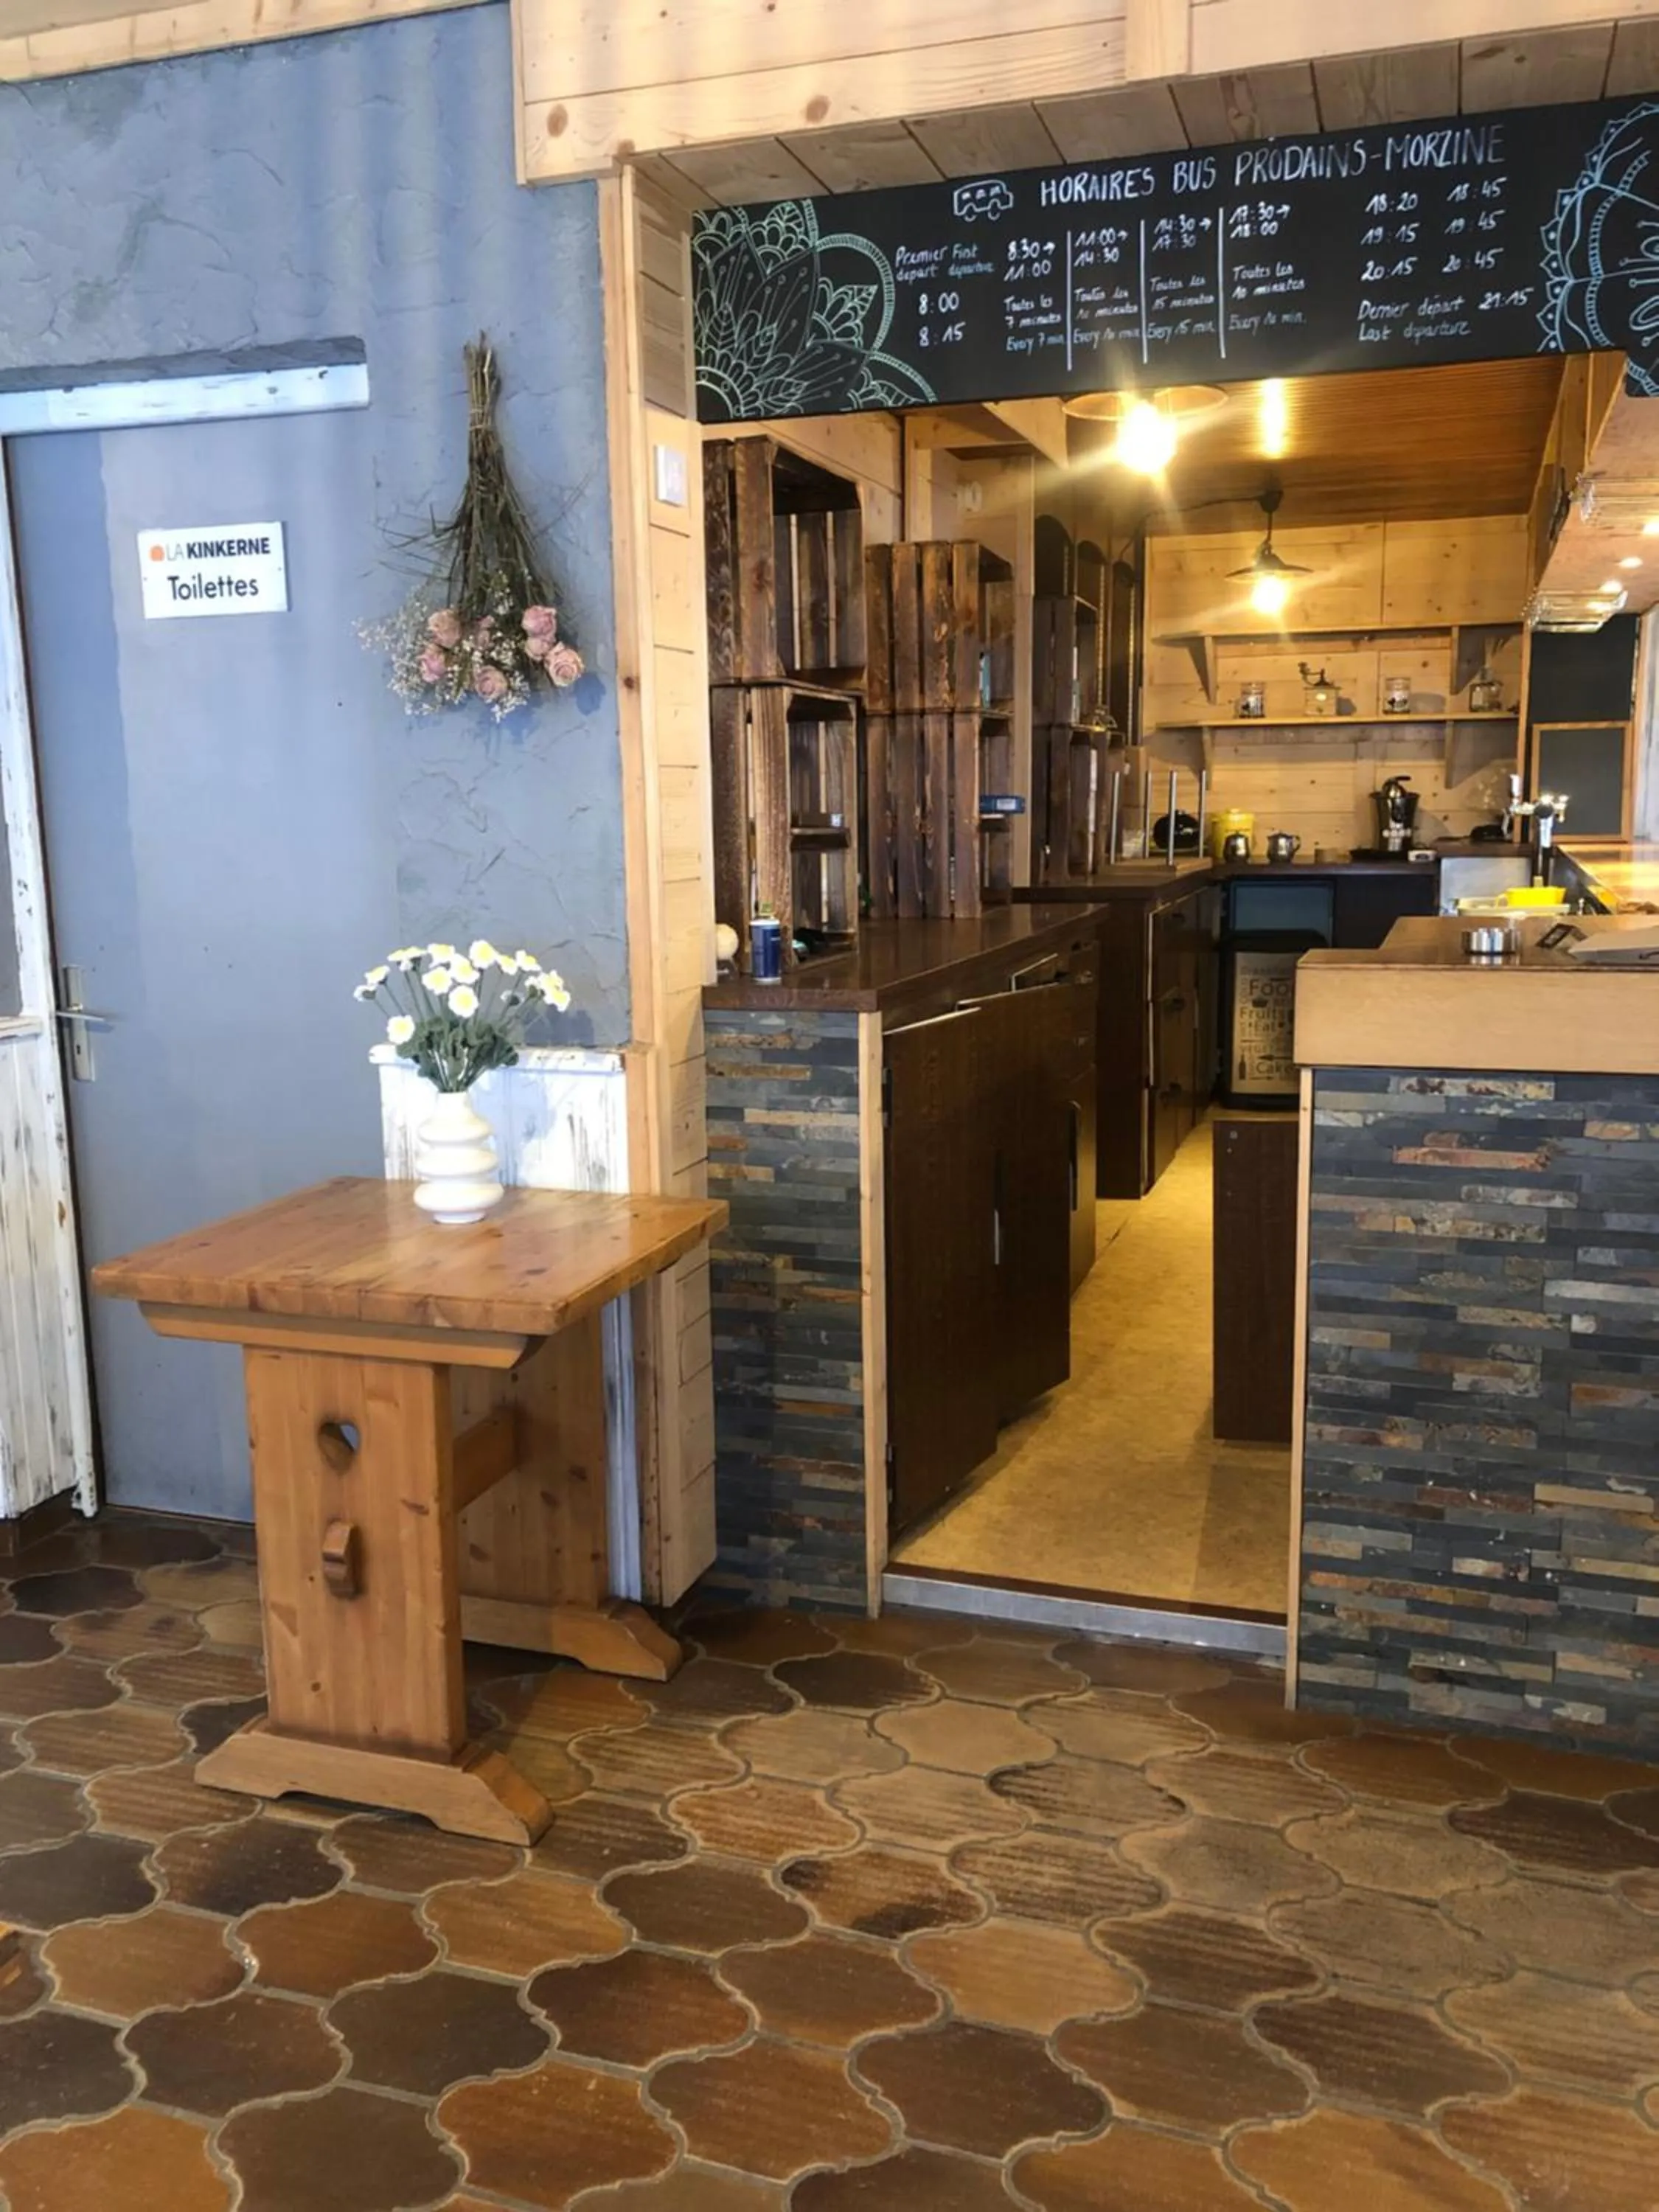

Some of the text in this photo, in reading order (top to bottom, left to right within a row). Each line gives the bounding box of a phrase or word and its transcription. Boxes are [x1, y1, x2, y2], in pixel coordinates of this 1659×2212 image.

[1040, 167, 1155, 206] HORAIRES
[1173, 156, 1216, 193] BUS
[1365, 177, 1507, 215] 18:20 18:45
[1154, 213, 1196, 234] 14:30
[1228, 201, 1275, 224] 17:30
[1074, 227, 1116, 248] 11:00
[1230, 221, 1279, 239] 18:00
[1360, 209, 1506, 245] 19:15 19:45
[895, 246, 947, 268] Premier
[1008, 238, 1040, 261] 8:30
[1074, 247, 1119, 267] 14:30
[1004, 260, 1051, 282] 11:00
[1232, 264, 1270, 282] Toutes
[1361, 248, 1504, 282] 20:15 20:45
[1073, 286, 1105, 302] Toutes
[1150, 276, 1183, 292] Toutes
[1253, 278, 1306, 296] minutes
[919, 292, 959, 315] 8:00
[1004, 295, 1034, 312] Toutes
[1094, 302, 1138, 318] minutes
[1169, 293, 1215, 308] minutes
[1357, 299, 1410, 321] Dernier
[1478, 288, 1534, 310] 21:15
[1005, 313, 1062, 329] 7 minutes
[1228, 314, 1261, 337] Every
[919, 322, 966, 347] 8:15
[1073, 328, 1100, 349] Every
[1147, 322, 1174, 344] Every
[1359, 321, 1472, 345] Last departure
[1006, 335, 1034, 355] Every
[187, 537, 271, 560] KINKERNE
[167, 572, 259, 601] Toilettes
